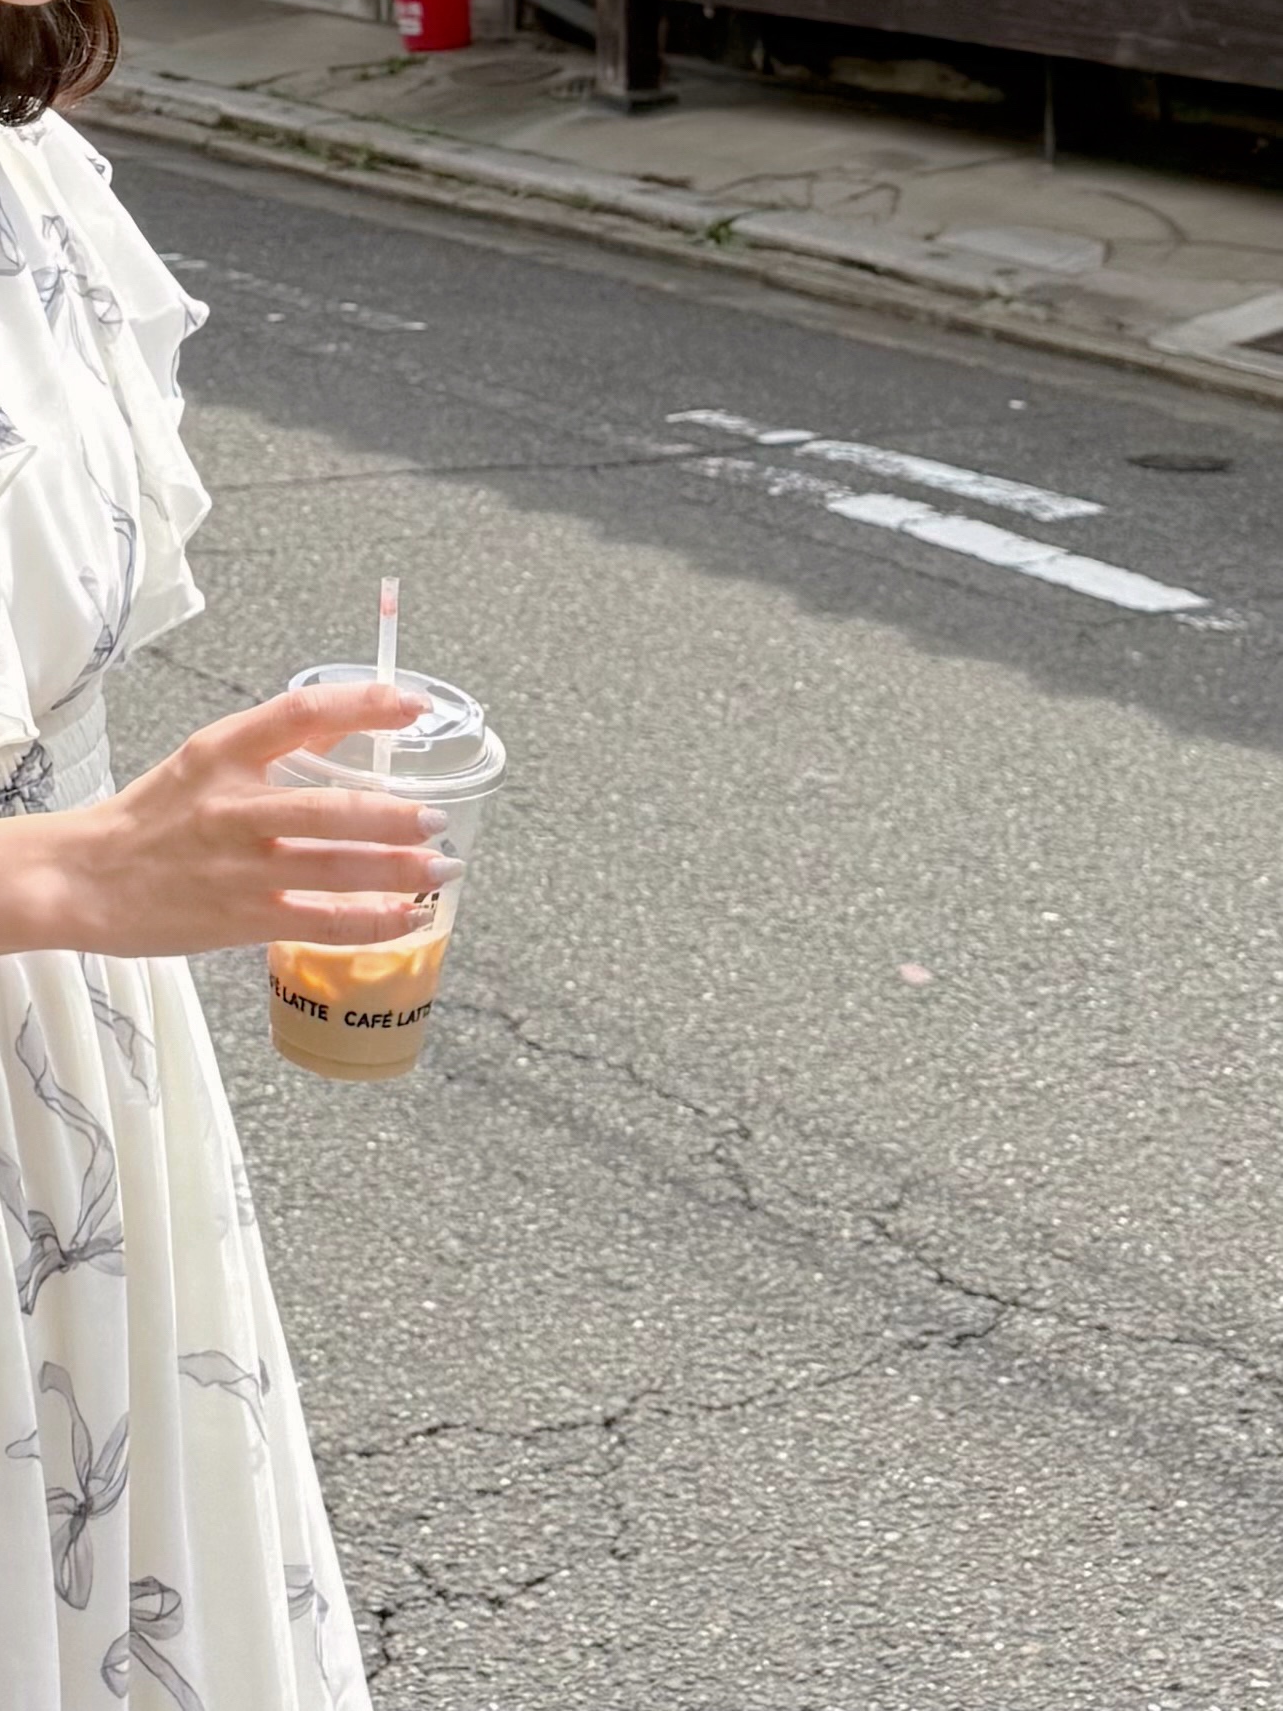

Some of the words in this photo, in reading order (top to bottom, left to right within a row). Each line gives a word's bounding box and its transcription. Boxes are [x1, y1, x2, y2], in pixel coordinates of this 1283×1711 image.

[283, 985, 329, 1021] LATTE
[344, 1009, 393, 1028] CAFÉ
[397, 1000, 433, 1027] LATT
